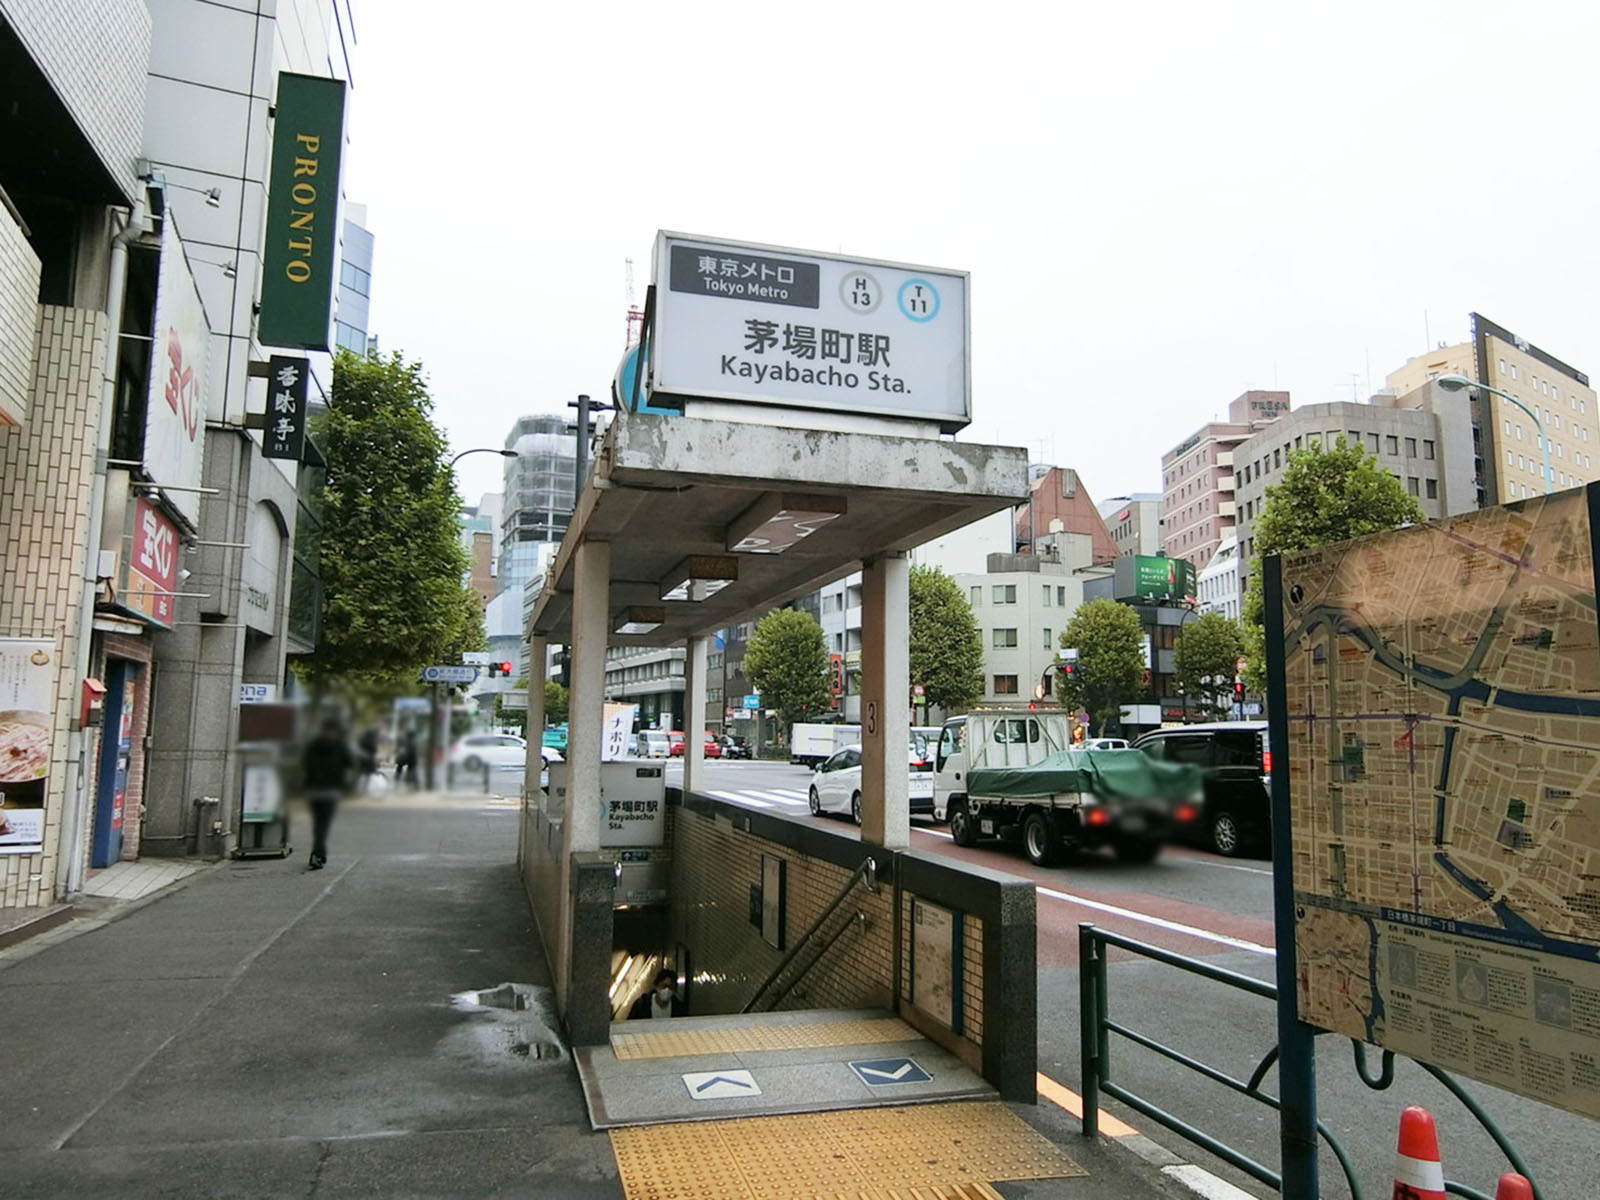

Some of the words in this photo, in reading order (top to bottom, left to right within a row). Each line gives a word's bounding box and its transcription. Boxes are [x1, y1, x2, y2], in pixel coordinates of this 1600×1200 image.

[285, 133, 320, 284] PRONTO
[698, 255, 795, 285] 東京メトロ
[703, 276, 744, 297] Tokyo
[747, 282, 789, 300] Metro
[855, 278, 867, 291] H
[914, 285, 924, 298] T
[851, 291, 871, 307] 13
[910, 299, 928, 314] 11
[743, 319, 891, 368] 茅場町駅
[721, 354, 859, 389] Kayabacho
[868, 371, 912, 395] Sta.
[140, 509, 173, 580] 宝くじ
[867, 702, 876, 735] 3
[609, 718, 624, 761] ナポリ
[609, 801, 659, 813] 茅場町駅
[609, 813, 655, 824] Kayabacho
